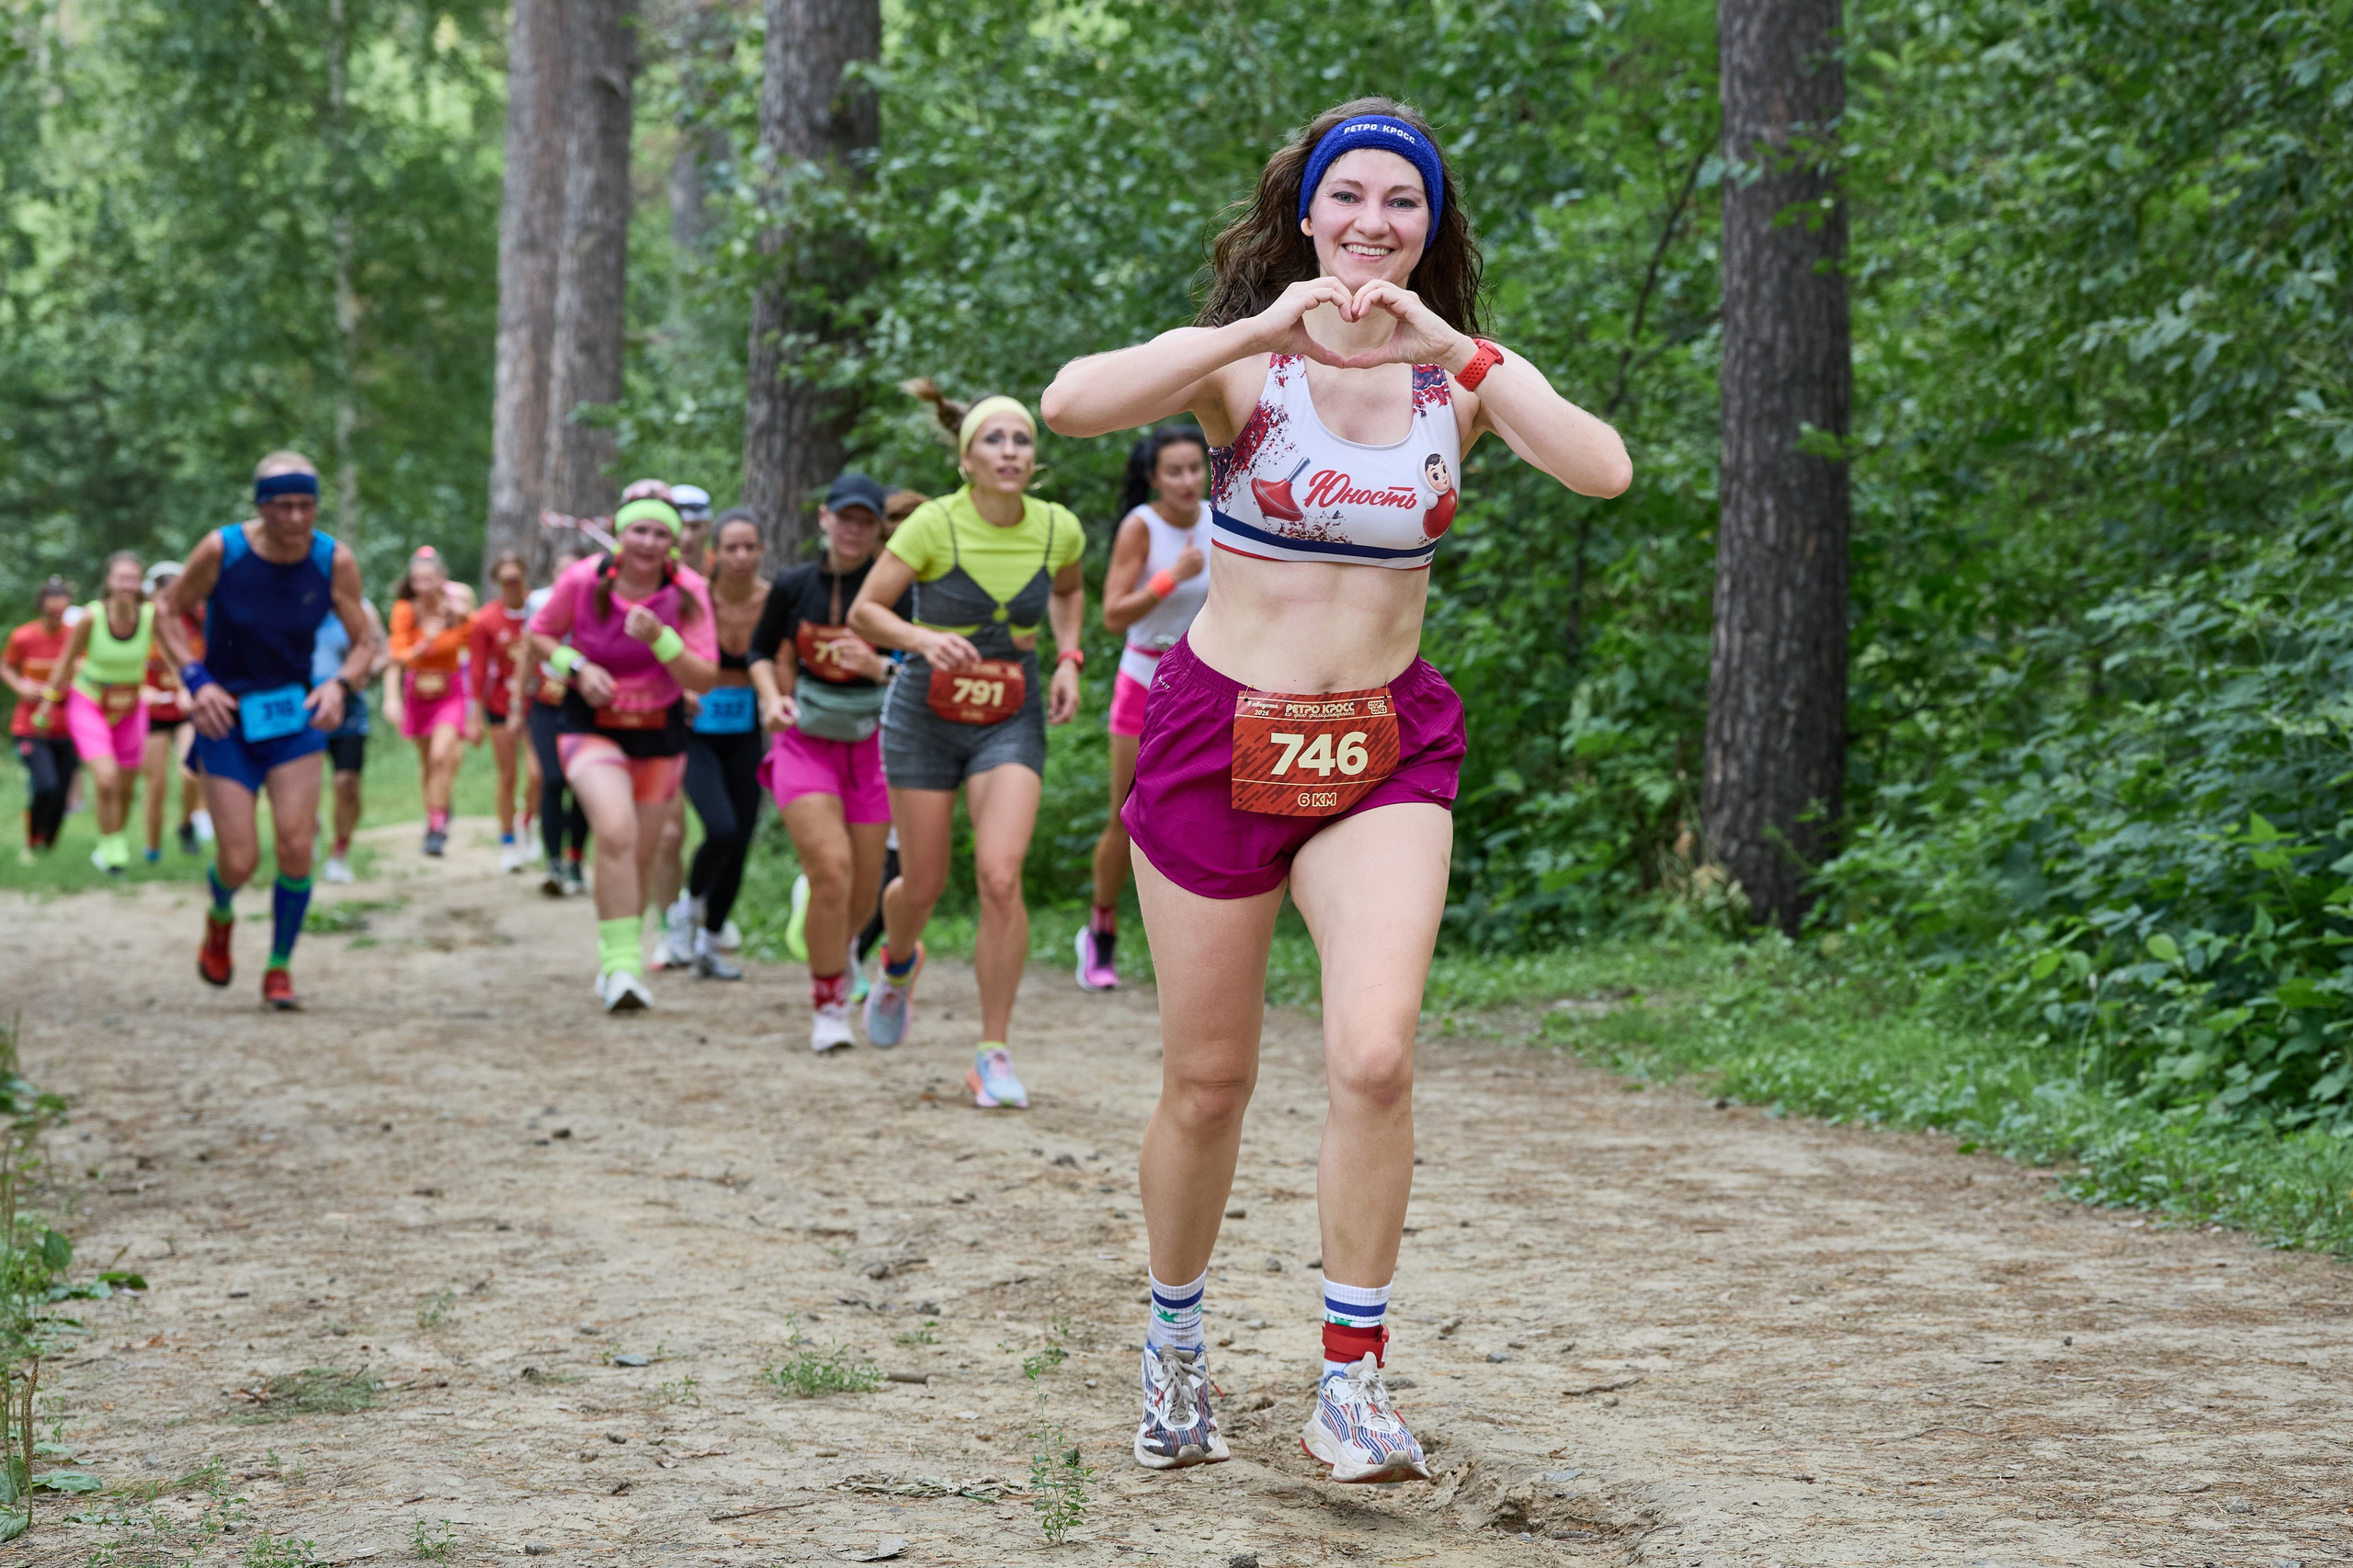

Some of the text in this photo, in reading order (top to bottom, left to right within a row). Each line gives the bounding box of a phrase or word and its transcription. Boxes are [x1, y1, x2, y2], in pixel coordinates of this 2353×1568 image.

[1344, 123, 1415, 144] РЕТРО КРОСС
[1303, 469, 1418, 510] Юность
[951, 676, 1006, 708] 791
[1254, 709, 1269, 717] 2026
[1285, 702, 1355, 714] РЕТРО КРОСС
[1270, 731, 1369, 777] 746
[1297, 792, 1311, 807] 6
